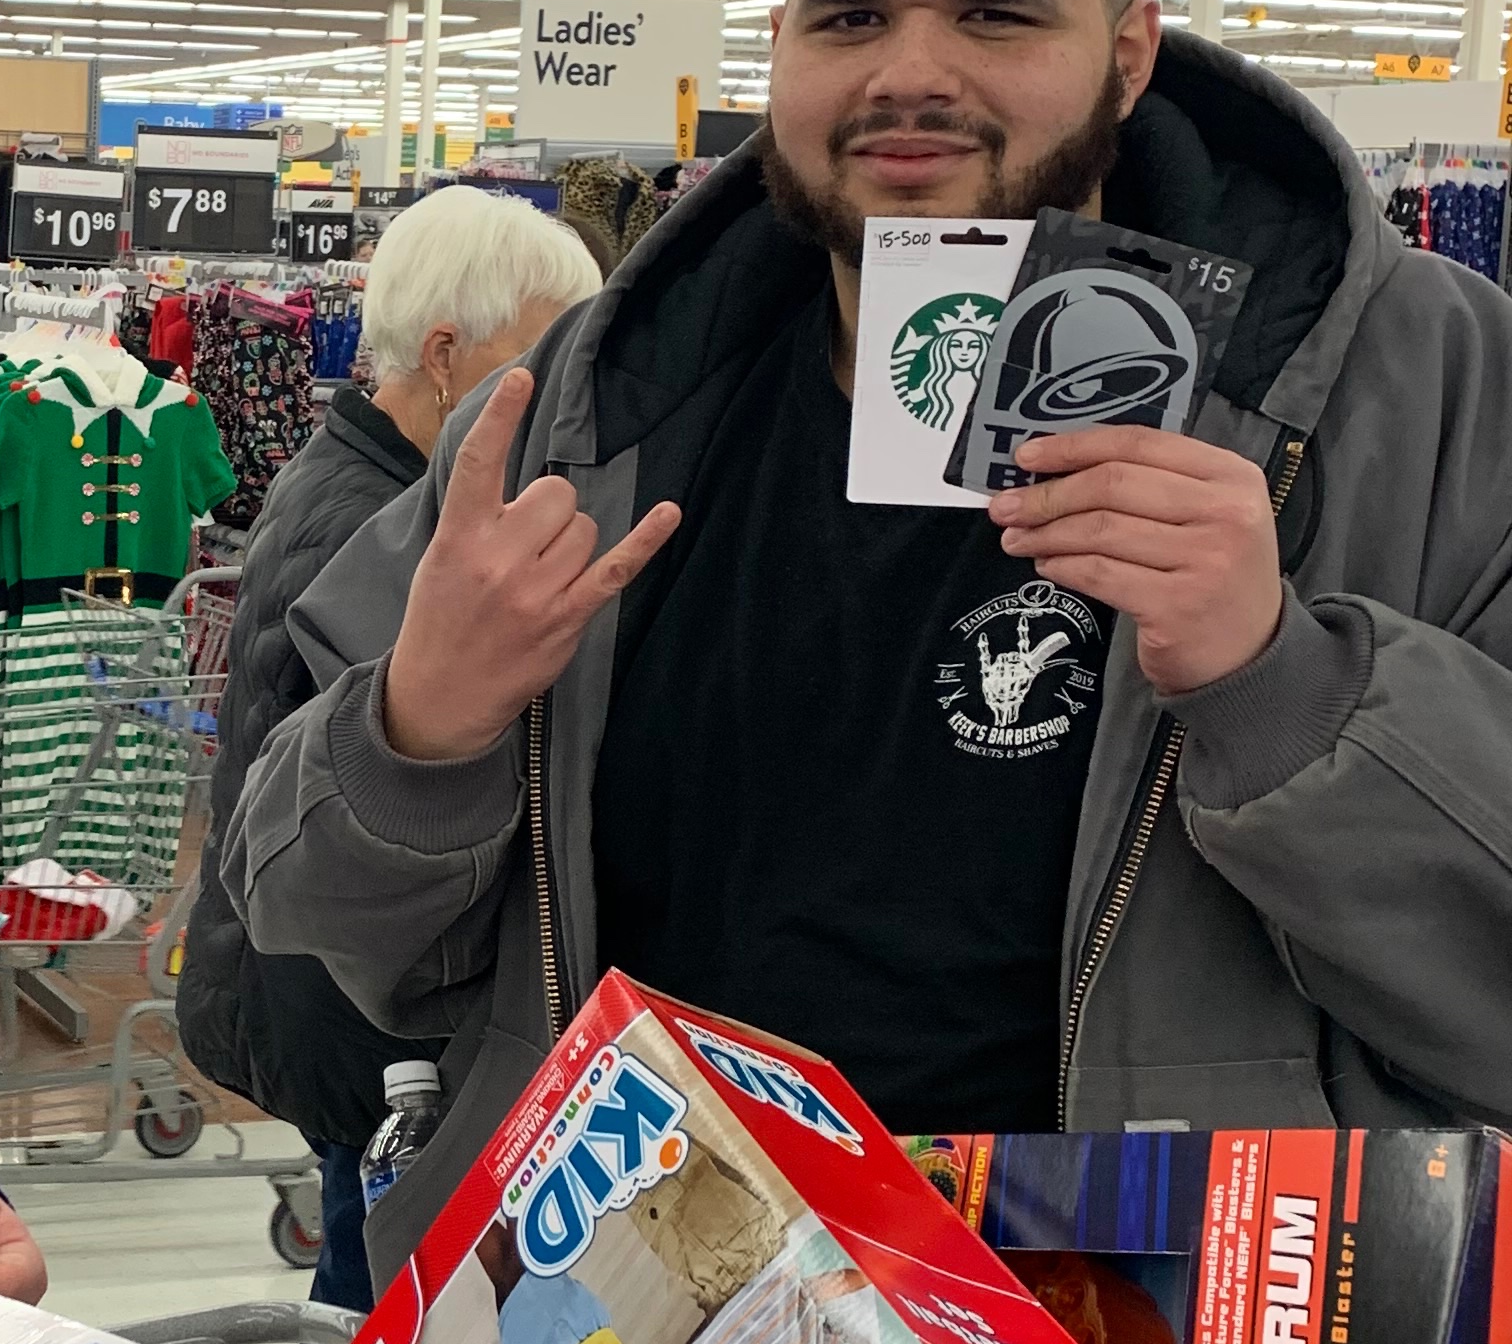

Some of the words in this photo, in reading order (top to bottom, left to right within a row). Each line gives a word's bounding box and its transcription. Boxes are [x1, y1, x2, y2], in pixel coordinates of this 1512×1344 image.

[537, 9, 644, 46] Ladies'
[534, 50, 617, 87] Wear
[1188, 255, 1237, 294] $15
[960, 597, 1020, 633] HAIRCUTS
[1058, 597, 1096, 634] SHAVES
[1069, 670, 1095, 687] 2019
[947, 710, 988, 742] KEEK'S
[988, 714, 1071, 745] BARBERSHOP
[954, 738, 1004, 759] HAIRCUTS
[1017, 738, 1059, 759] SHAVES
[567, 1030, 590, 1062] 3+
[696, 1040, 858, 1138] KID
[493, 1105, 549, 1180] WARNING:
[522, 1063, 680, 1267] KID
[969, 1146, 988, 1205] ACTION
[1241, 1143, 1259, 1220] Blasters
[1224, 1156, 1244, 1235] Blasters
[1201, 1225, 1221, 1327] Compatible
[1212, 1183, 1225, 1222] with
[1331, 1232, 1356, 1344] Blaster
[929, 1294, 995, 1335] Set
